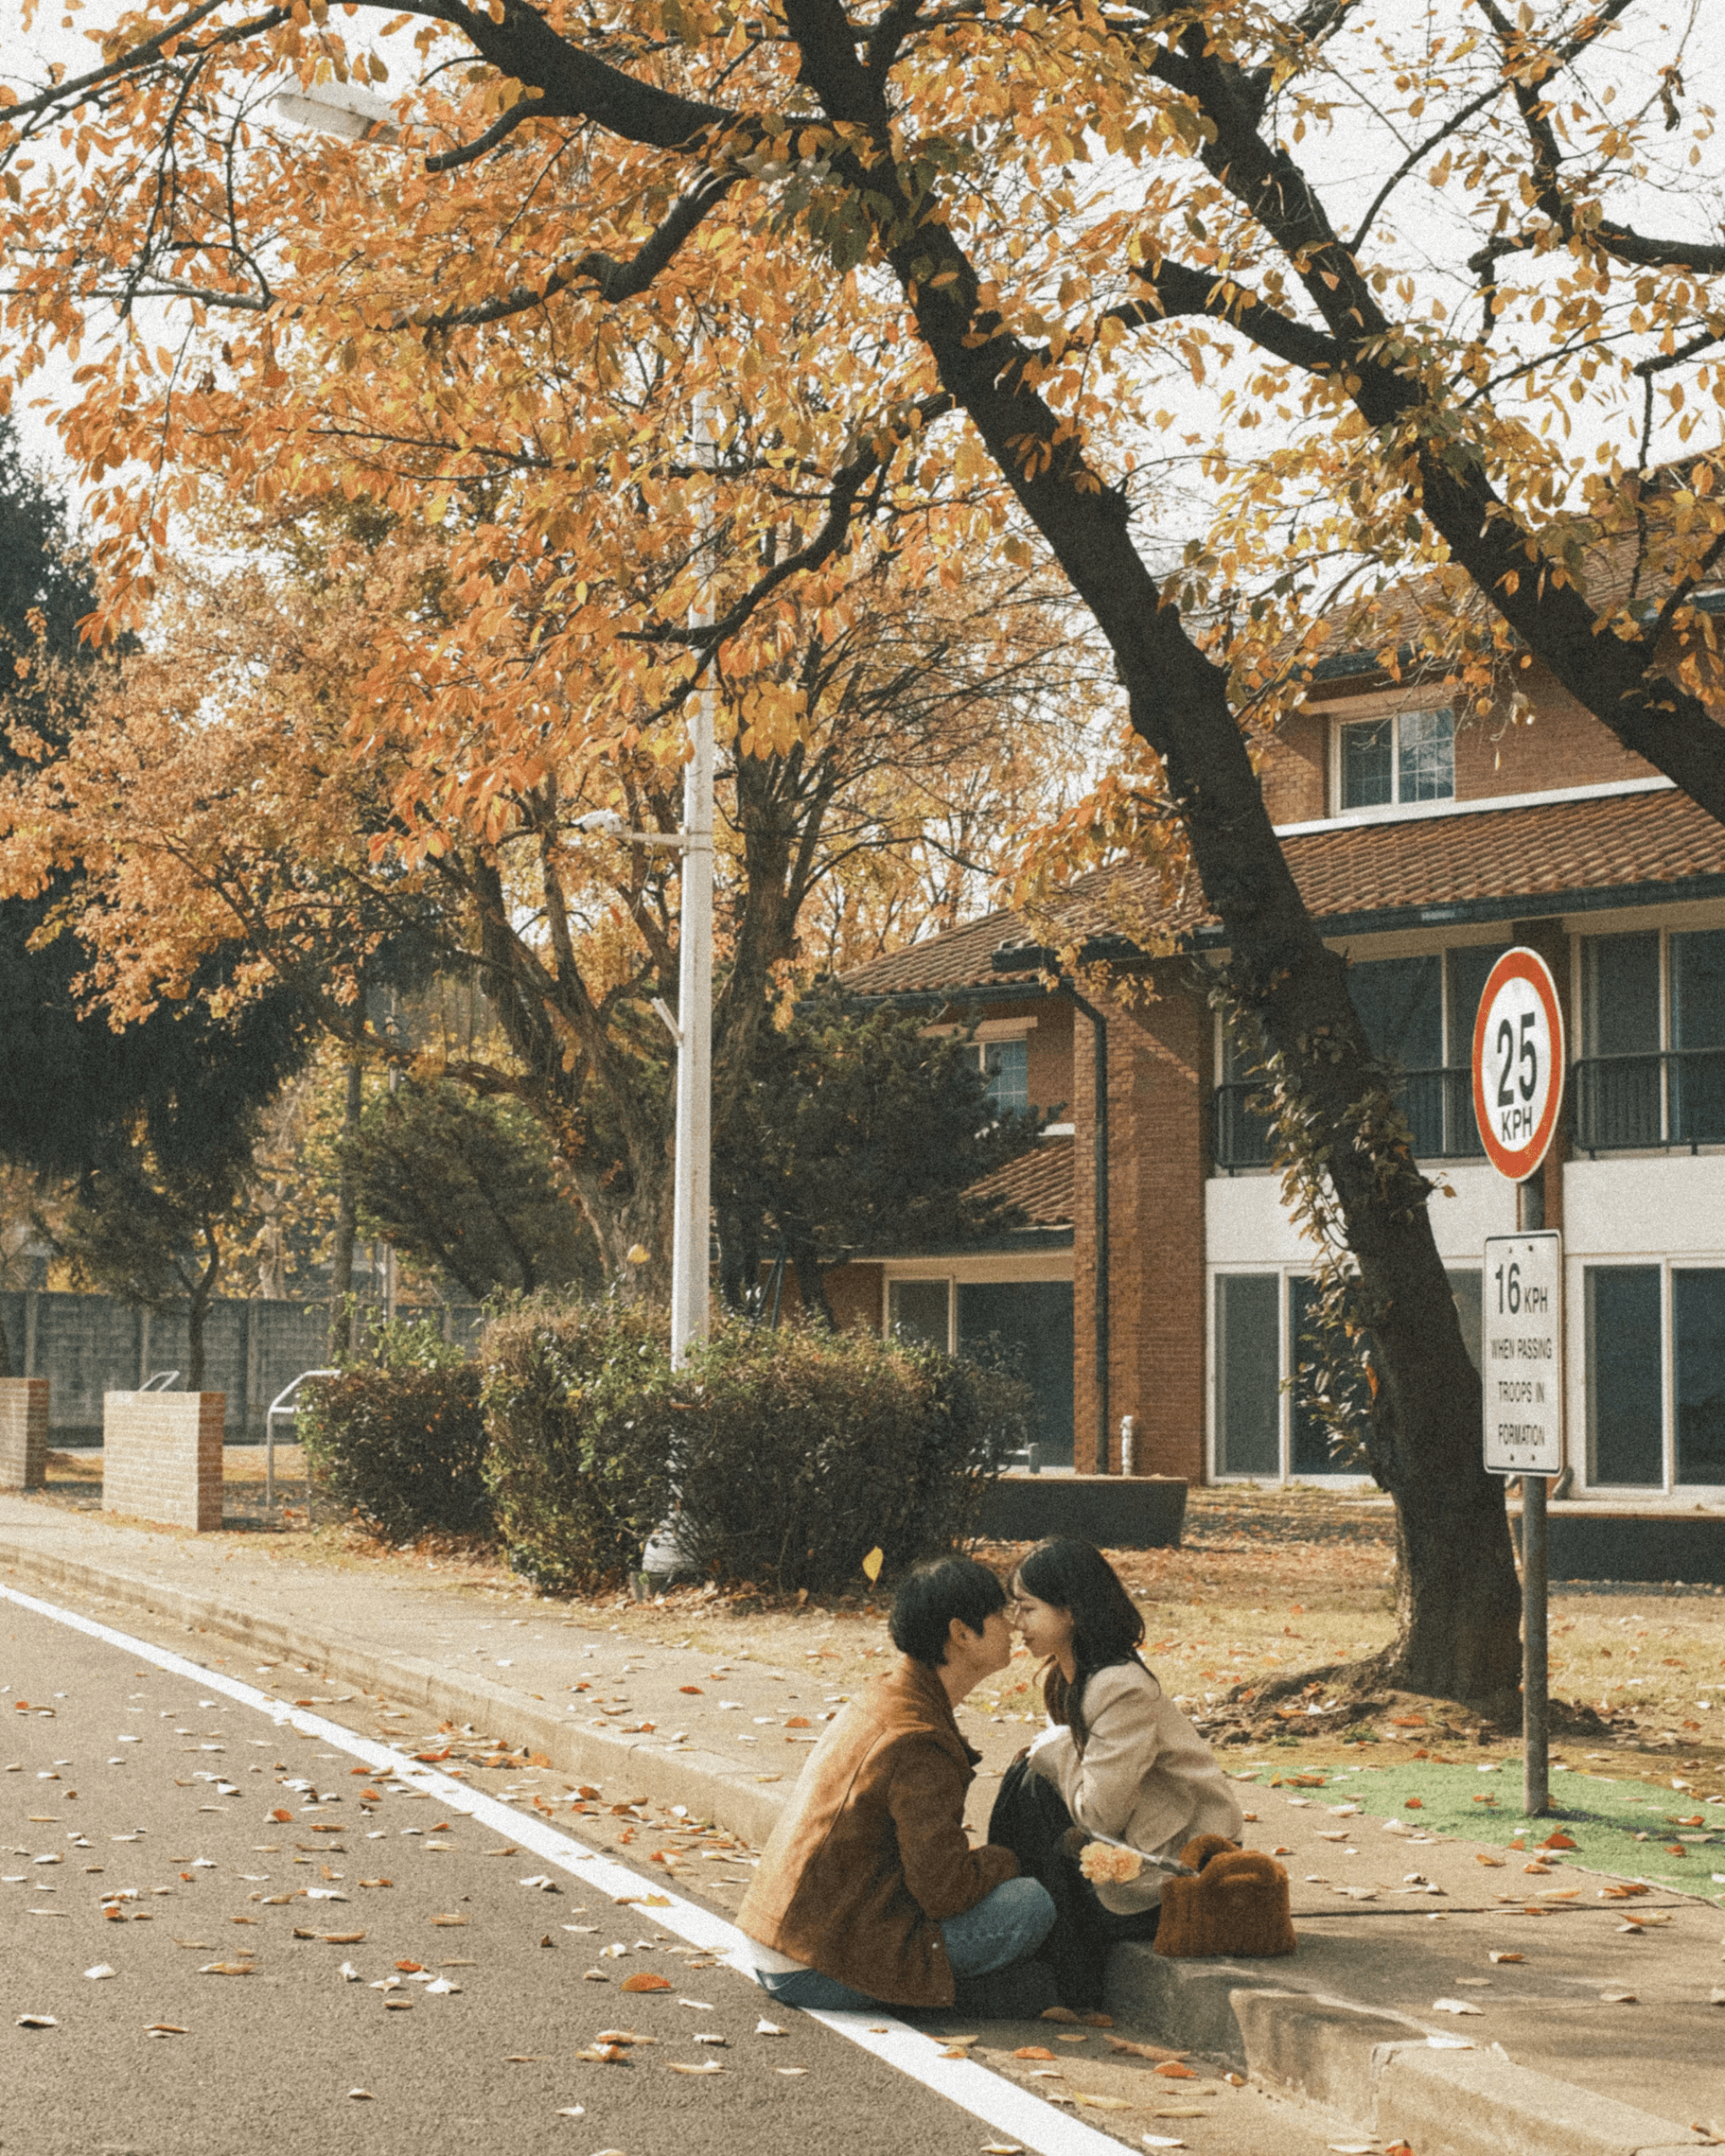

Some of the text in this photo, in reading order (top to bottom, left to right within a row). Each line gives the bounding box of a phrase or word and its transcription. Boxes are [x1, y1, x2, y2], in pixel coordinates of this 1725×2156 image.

[1497, 1011, 1537, 1107] 25
[1501, 1106, 1533, 1142] KPH
[1495, 1262, 1548, 1315] 16 KPH
[1491, 1338, 1552, 1359] WHEN PASSING
[1498, 1381, 1545, 1403] TROOPS IN
[1498, 1423, 1546, 1446] FORMATION
